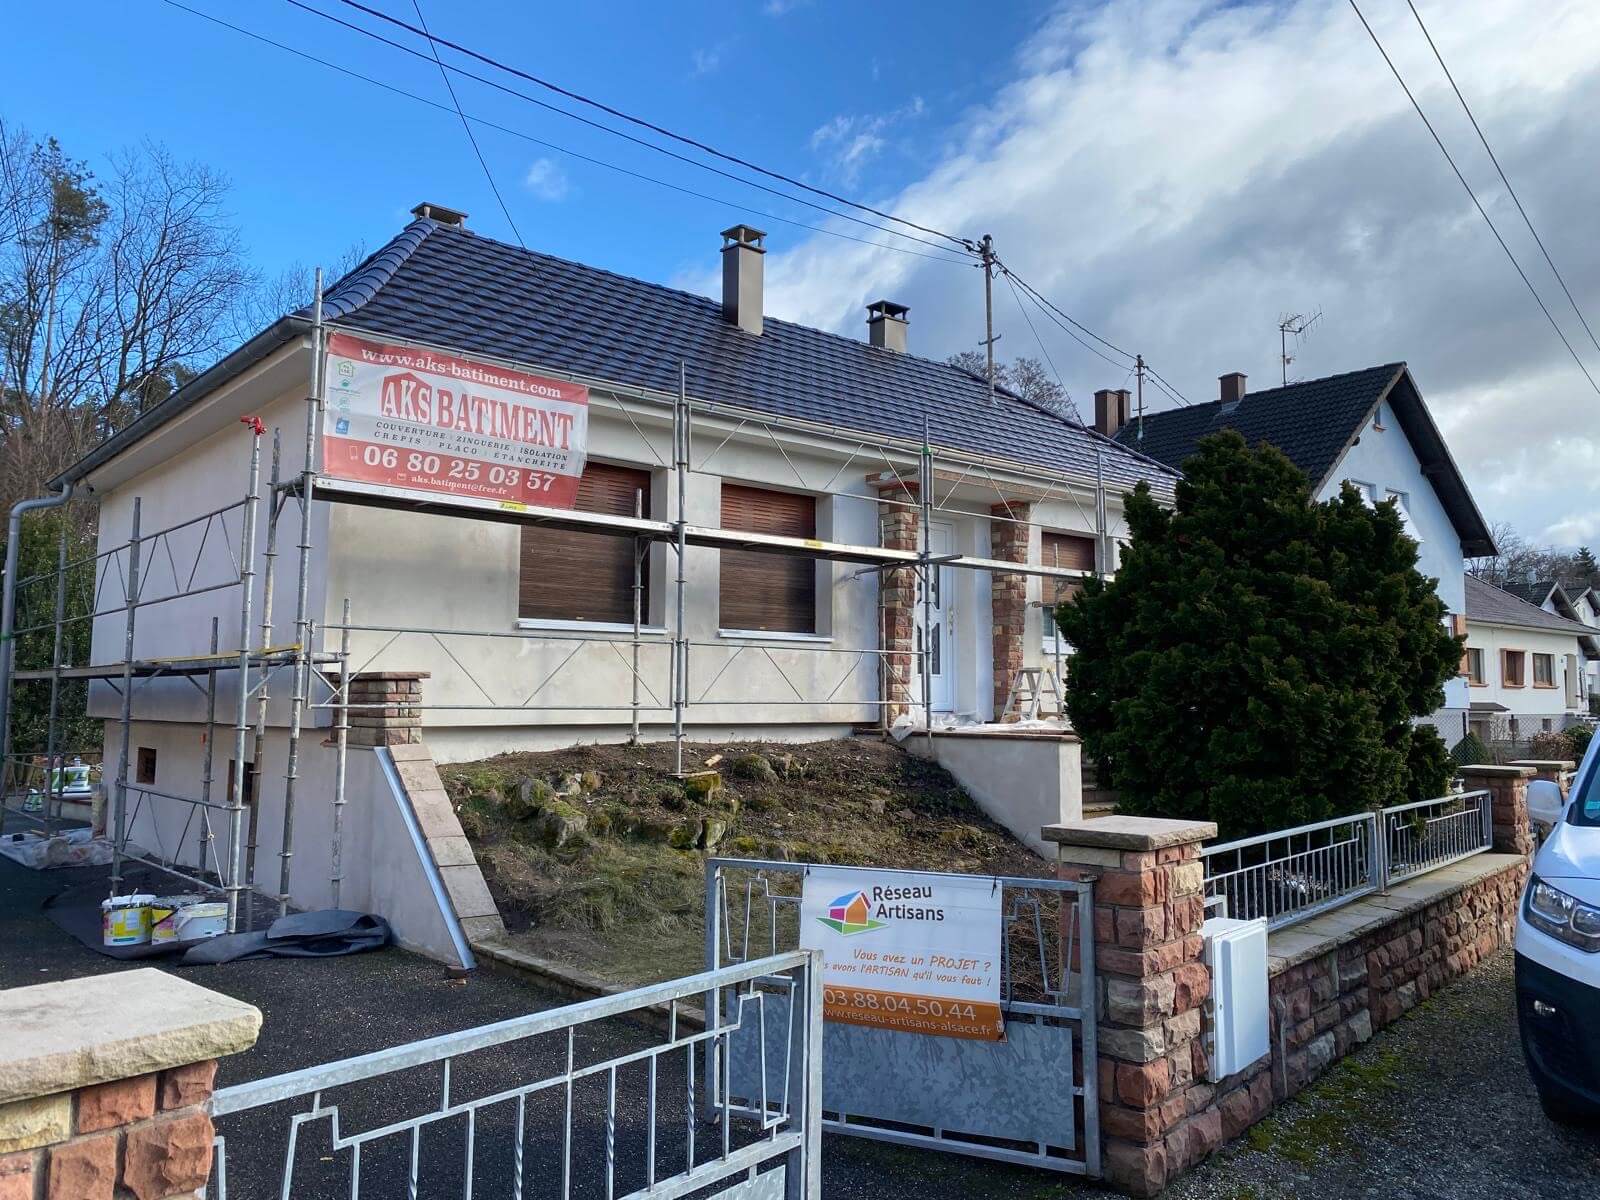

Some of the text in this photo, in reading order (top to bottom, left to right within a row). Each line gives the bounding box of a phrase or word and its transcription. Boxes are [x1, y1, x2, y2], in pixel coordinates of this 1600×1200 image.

[361, 349, 562, 398] www.aks-batiment.com
[382, 379, 574, 450] AKS BATIMENT
[374, 431, 421, 446] CREPIS
[439, 441, 477, 455] PLACO
[376, 421, 568, 461] COUVERTURE ZINGUERIE ISOLATION
[363, 445, 556, 491] 06 80 25 03 57
[411, 475, 508, 495] aks.batiment@free.fr
[873, 885, 932, 901] Réseau
[876, 904, 944, 921] Artisans
[854, 949, 992, 973] Vous avez un PROJET ?
[832, 963, 856, 973] avons
[861, 964, 909, 977] l'ARTISAN
[912, 970, 932, 982] qu'il
[936, 974, 957, 983] vous
[961, 975, 982, 985] faut
[987, 977, 992, 986] !
[823, 988, 977, 1021] 03.88.04.50.44
[824, 1008, 992, 1035] ww.reseau-artisans-alsace.fr
